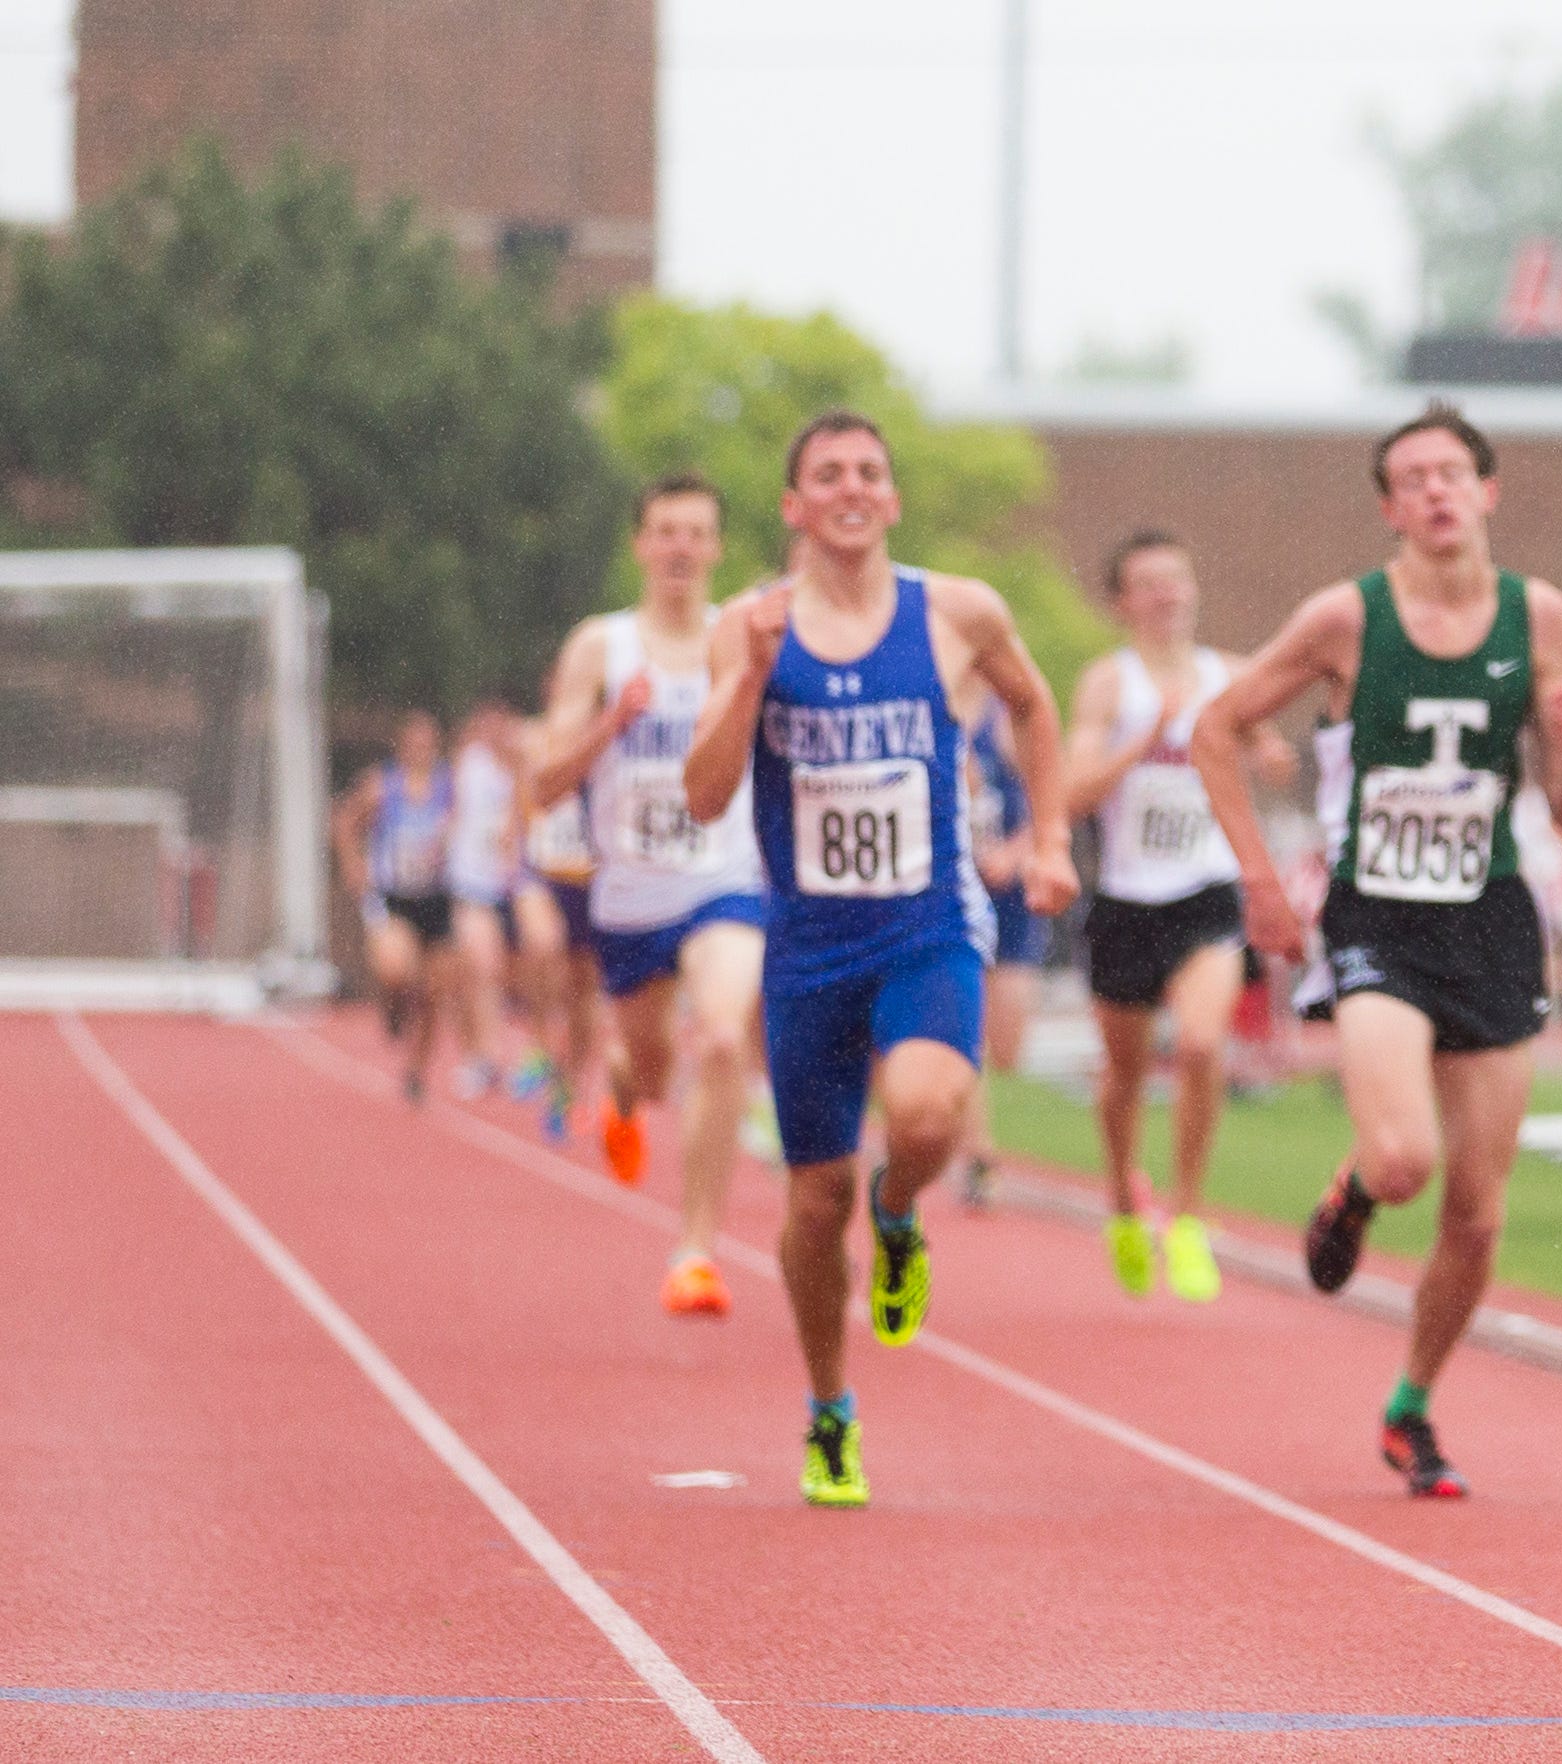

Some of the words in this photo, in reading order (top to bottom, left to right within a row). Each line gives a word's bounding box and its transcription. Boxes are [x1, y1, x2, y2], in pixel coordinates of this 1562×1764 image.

[763, 699, 935, 762] GENEVA
[1405, 698, 1491, 772] T
[821, 808, 902, 882] 881
[1365, 810, 1485, 884] 2058
